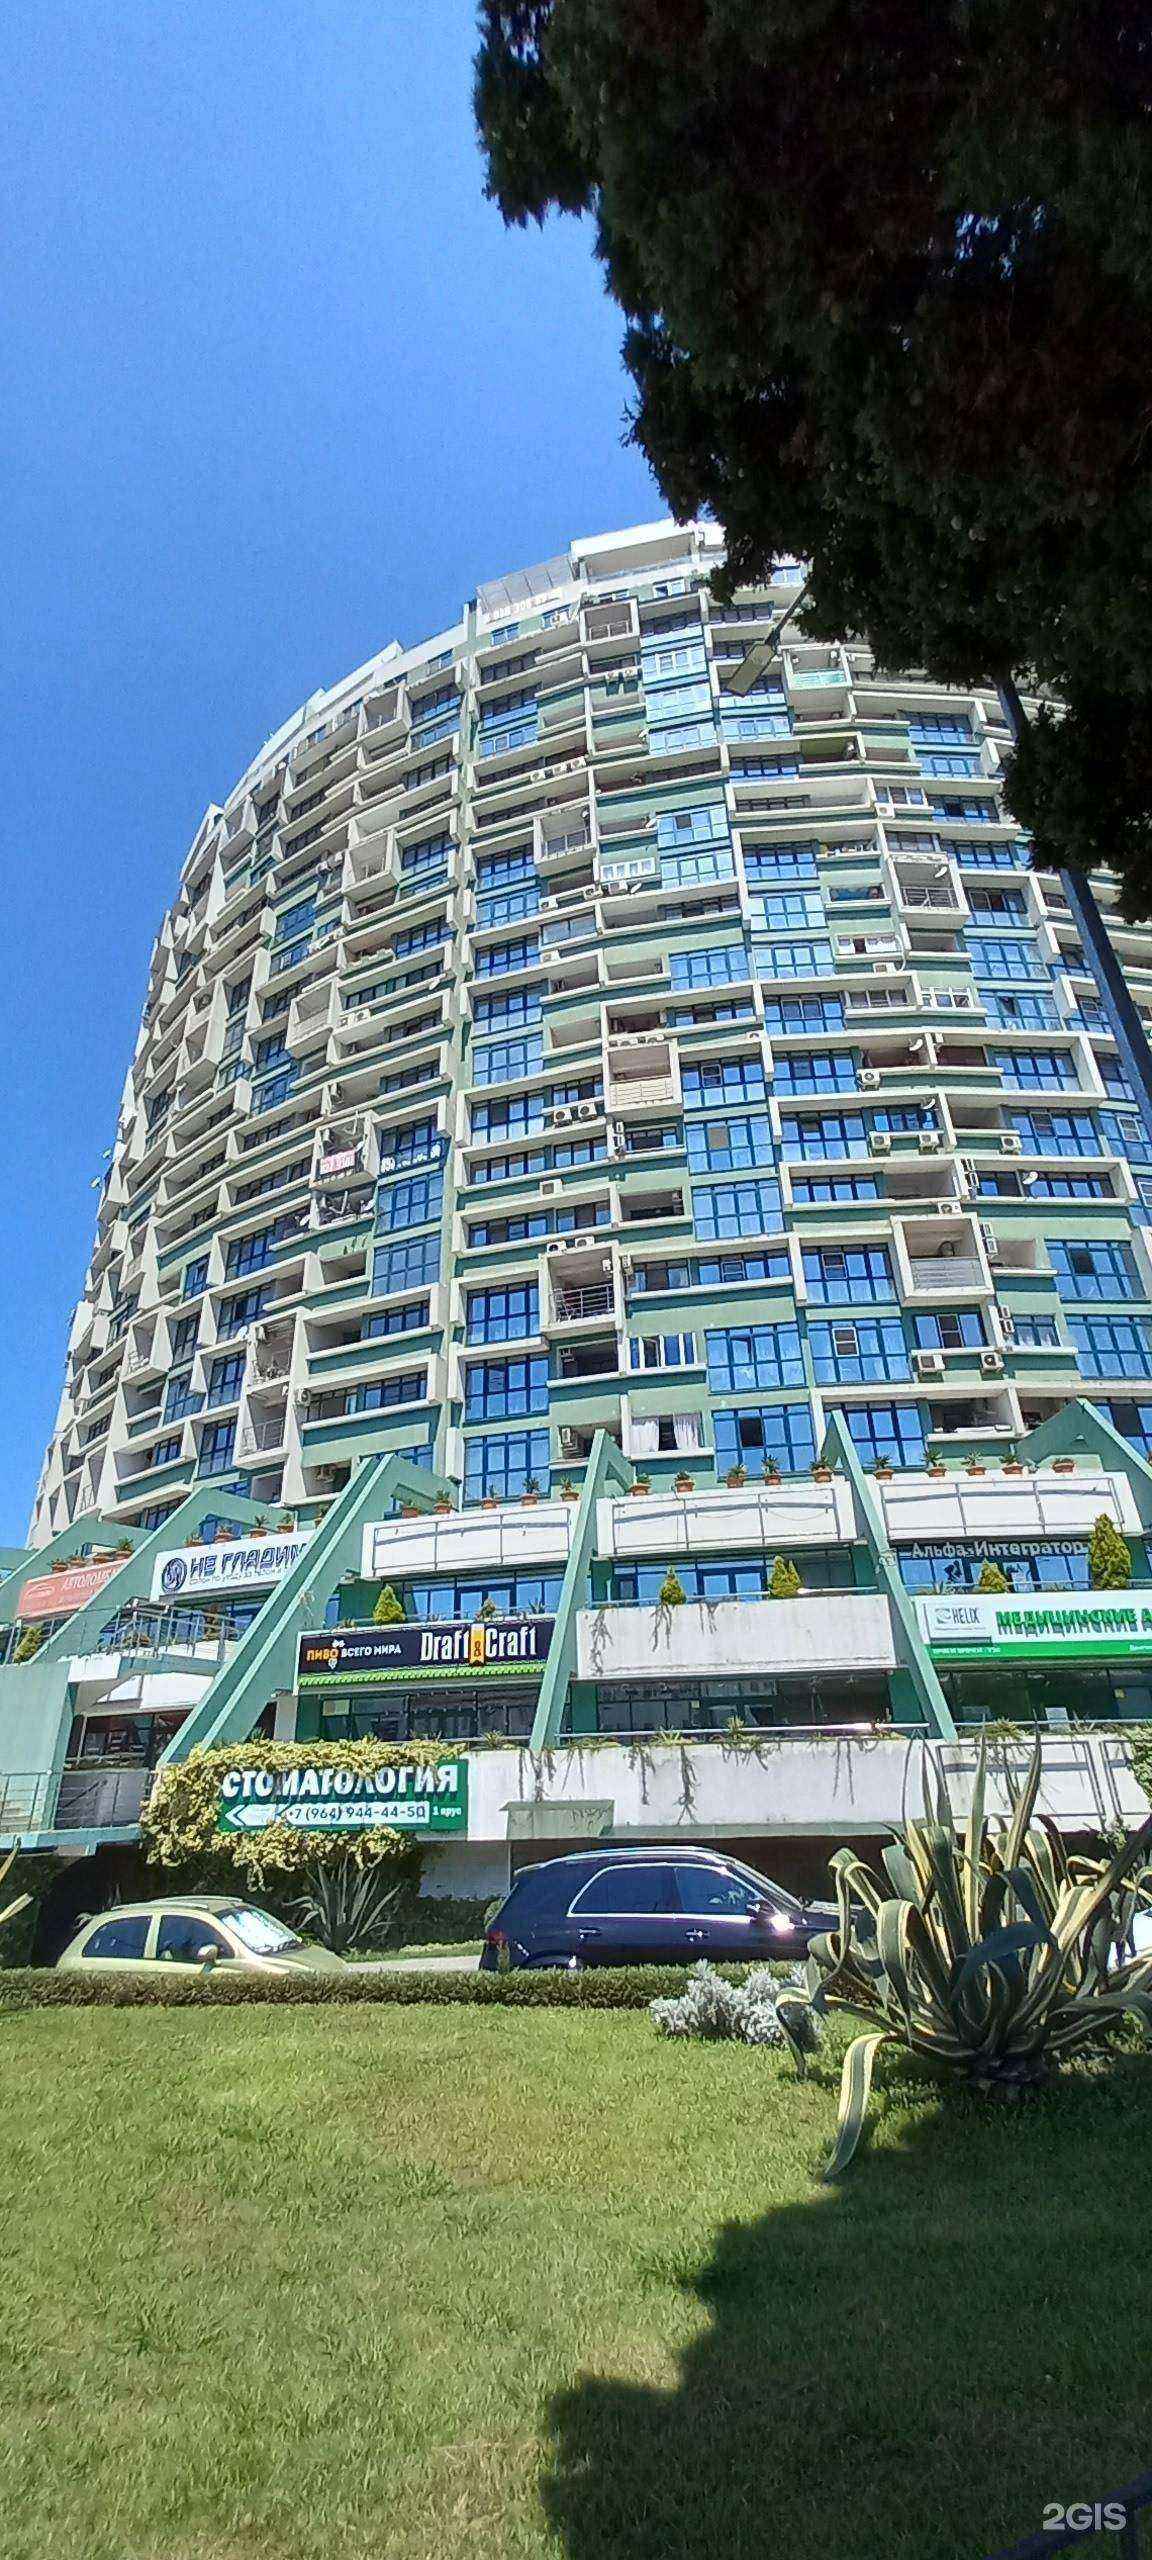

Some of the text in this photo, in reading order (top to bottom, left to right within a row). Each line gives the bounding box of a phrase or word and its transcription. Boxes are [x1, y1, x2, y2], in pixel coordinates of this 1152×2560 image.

[911, 1540, 1083, 1558] Альфа-Интегратор
[190, 1555, 217, 1578] НЕ
[220, 1543, 306, 1574] ГЛАДИМ
[952, 1607, 980, 1624] HELIX
[996, 1608, 1138, 1629] МЕДИЦИНСКИЕ
[306, 1643, 402, 1662] ПИВО ВСЕГО МИРА
[420, 1628, 469, 1661] Draft
[485, 1626, 536, 1657] Craft
[305, 1806, 342, 1821] (964)
[346, 1805, 426, 1818] 944-44-50
